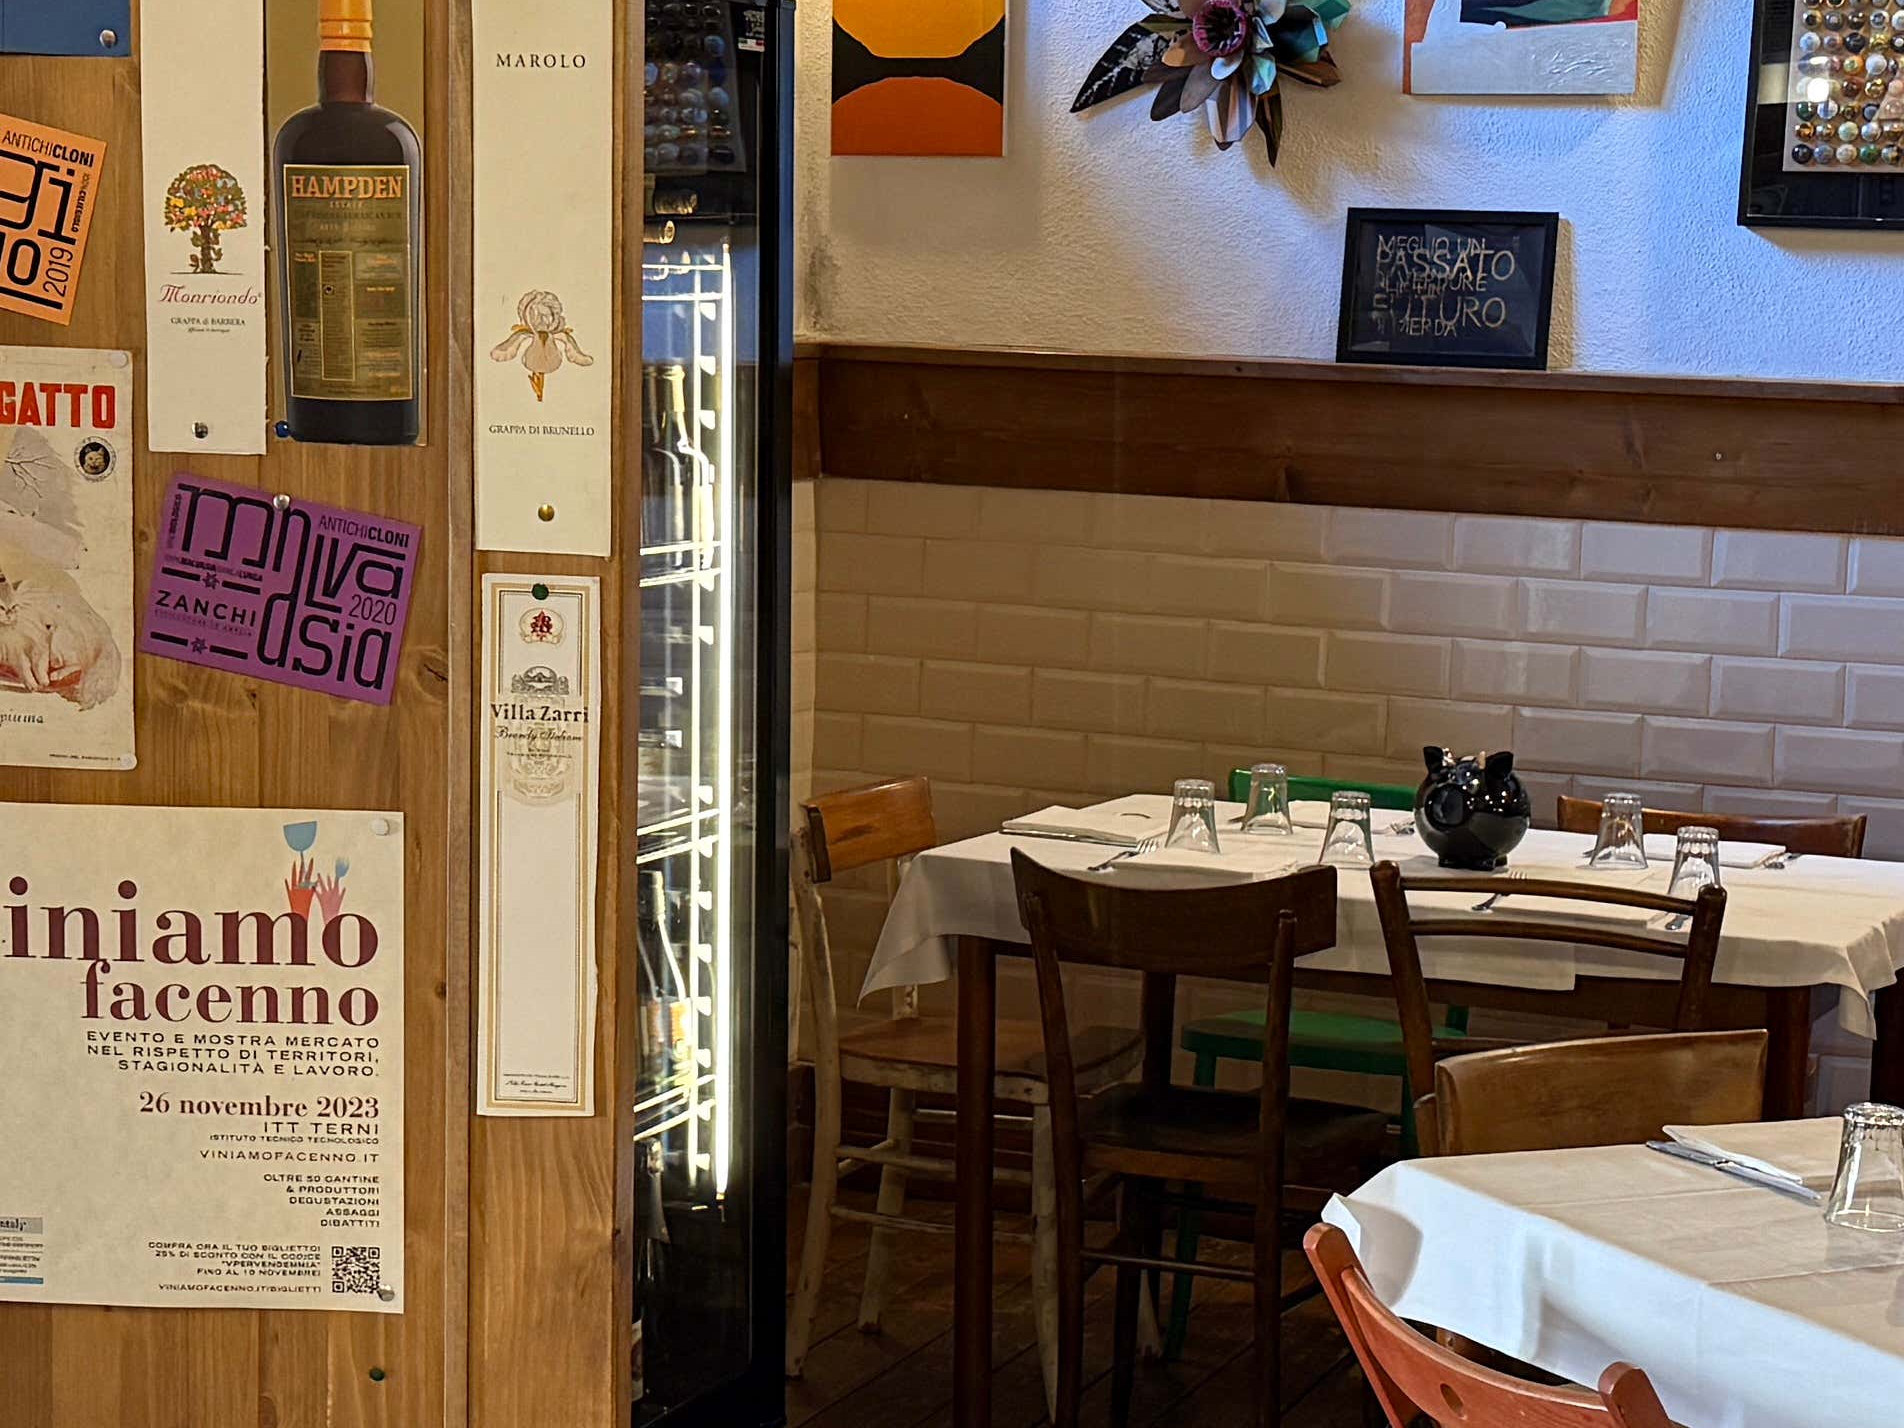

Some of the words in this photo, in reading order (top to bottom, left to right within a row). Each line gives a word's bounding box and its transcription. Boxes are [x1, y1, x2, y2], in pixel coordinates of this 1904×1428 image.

[496, 53, 586, 68] MAROLO
[291, 175, 403, 199] HAMPDEN
[43, 247, 75, 298] 2019
[1377, 249, 1515, 281] PASSATO
[489, 425, 526, 435] GRAPPA
[155, 590, 257, 627] ZANCHI
[348, 594, 397, 626] 2020
[490, 703, 535, 721] Villa
[540, 706, 590, 723] Zarri
[80, 957, 380, 1026] facenno
[87, 1031, 165, 1044] EVENTO
[175, 1034, 184, 1044] E
[193, 1034, 276, 1046] MOSTRA
[286, 1036, 380, 1048] MERCATO
[88, 1045, 124, 1056] NEL
[133, 1046, 229, 1060] RISPETTO
[240, 1049, 257, 1060] DI
[266, 1049, 380, 1064] TERRITORI,
[275, 1064, 285, 1074] E
[294, 1065, 380, 1077] LAVORO.
[139, 1091, 170, 1114] 26
[180, 1095, 308, 1118] novembre
[316, 1096, 380, 1119] 2023
[264, 1122, 299, 1133] ITT
[310, 1122, 379, 1135] TERNI
[200, 1150, 380, 1163] VINIAMOFACENNO.IT
[263, 1173, 302, 1183] OLTRE
[299, 1185, 380, 1194] PRODUTTORI
[289, 1196, 380, 1205] DEGUSTAZIONI
